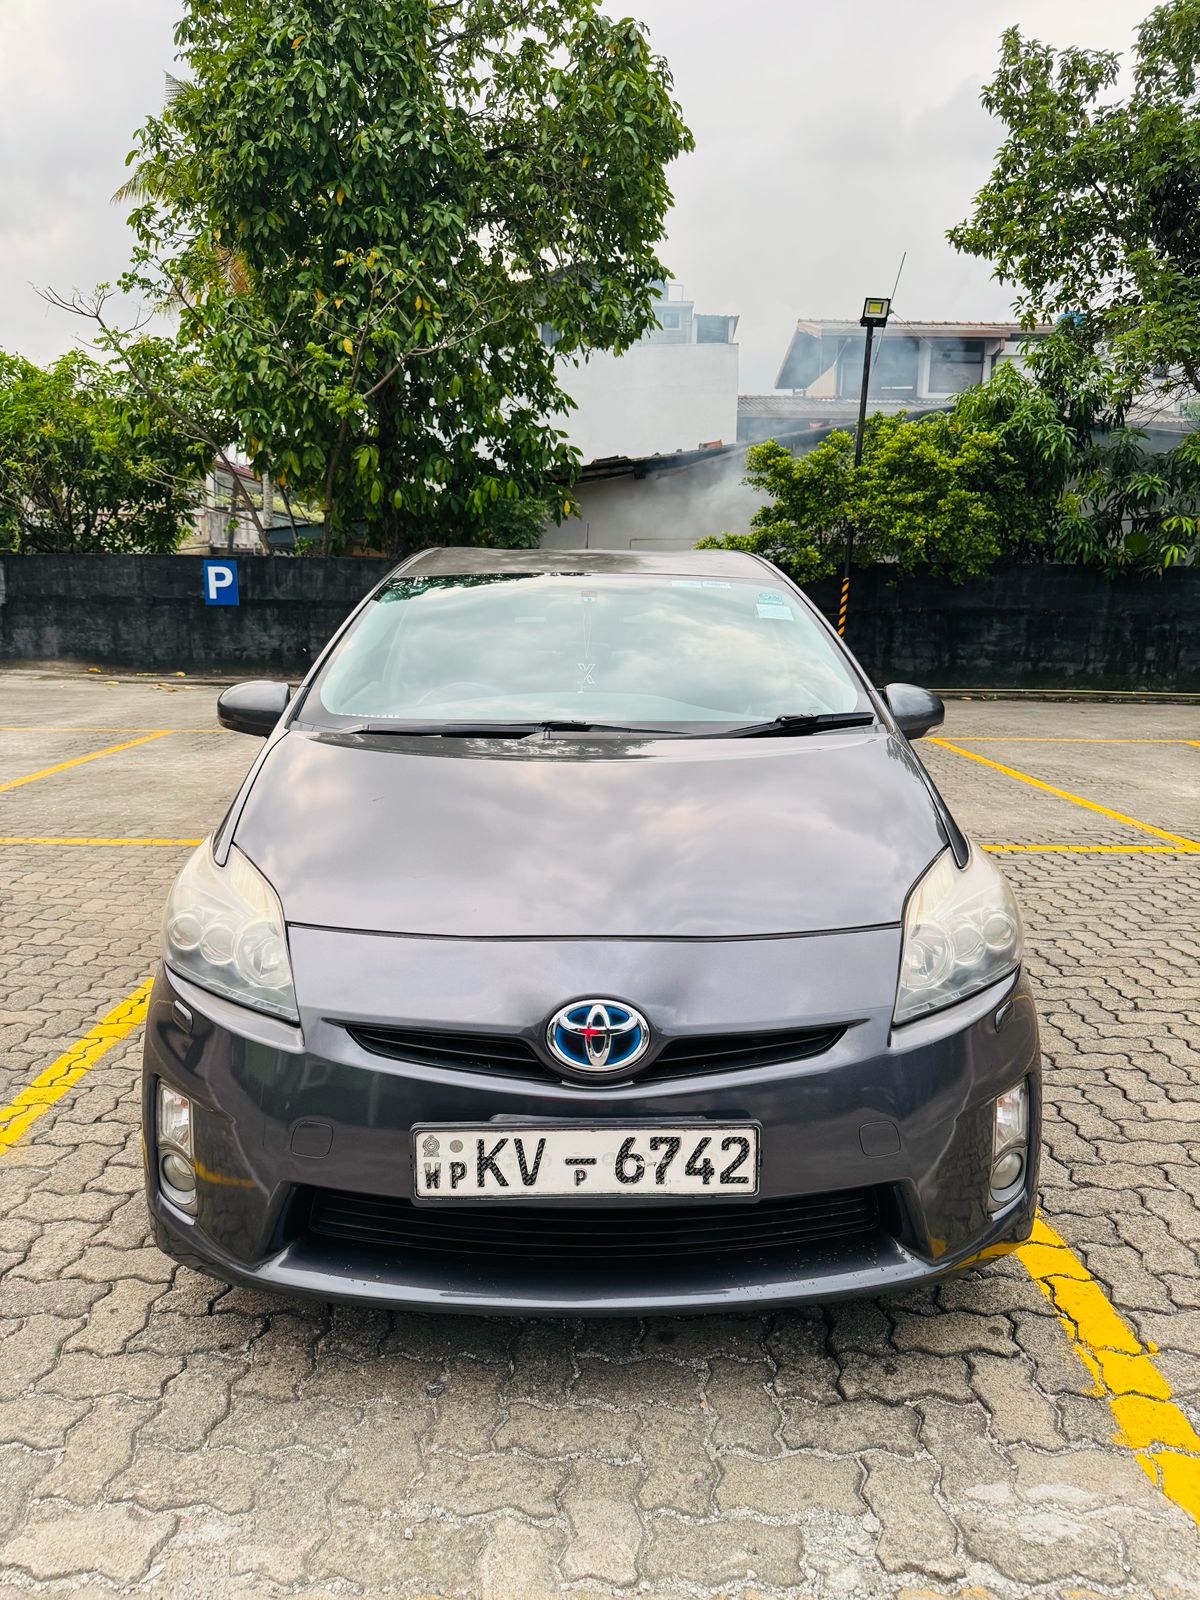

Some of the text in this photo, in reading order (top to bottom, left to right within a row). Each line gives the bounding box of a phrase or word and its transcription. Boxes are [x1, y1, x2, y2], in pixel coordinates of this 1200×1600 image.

[207, 566, 233, 600] P
[476, 1137, 547, 1188] KV
[614, 1136, 751, 1185] 6742
